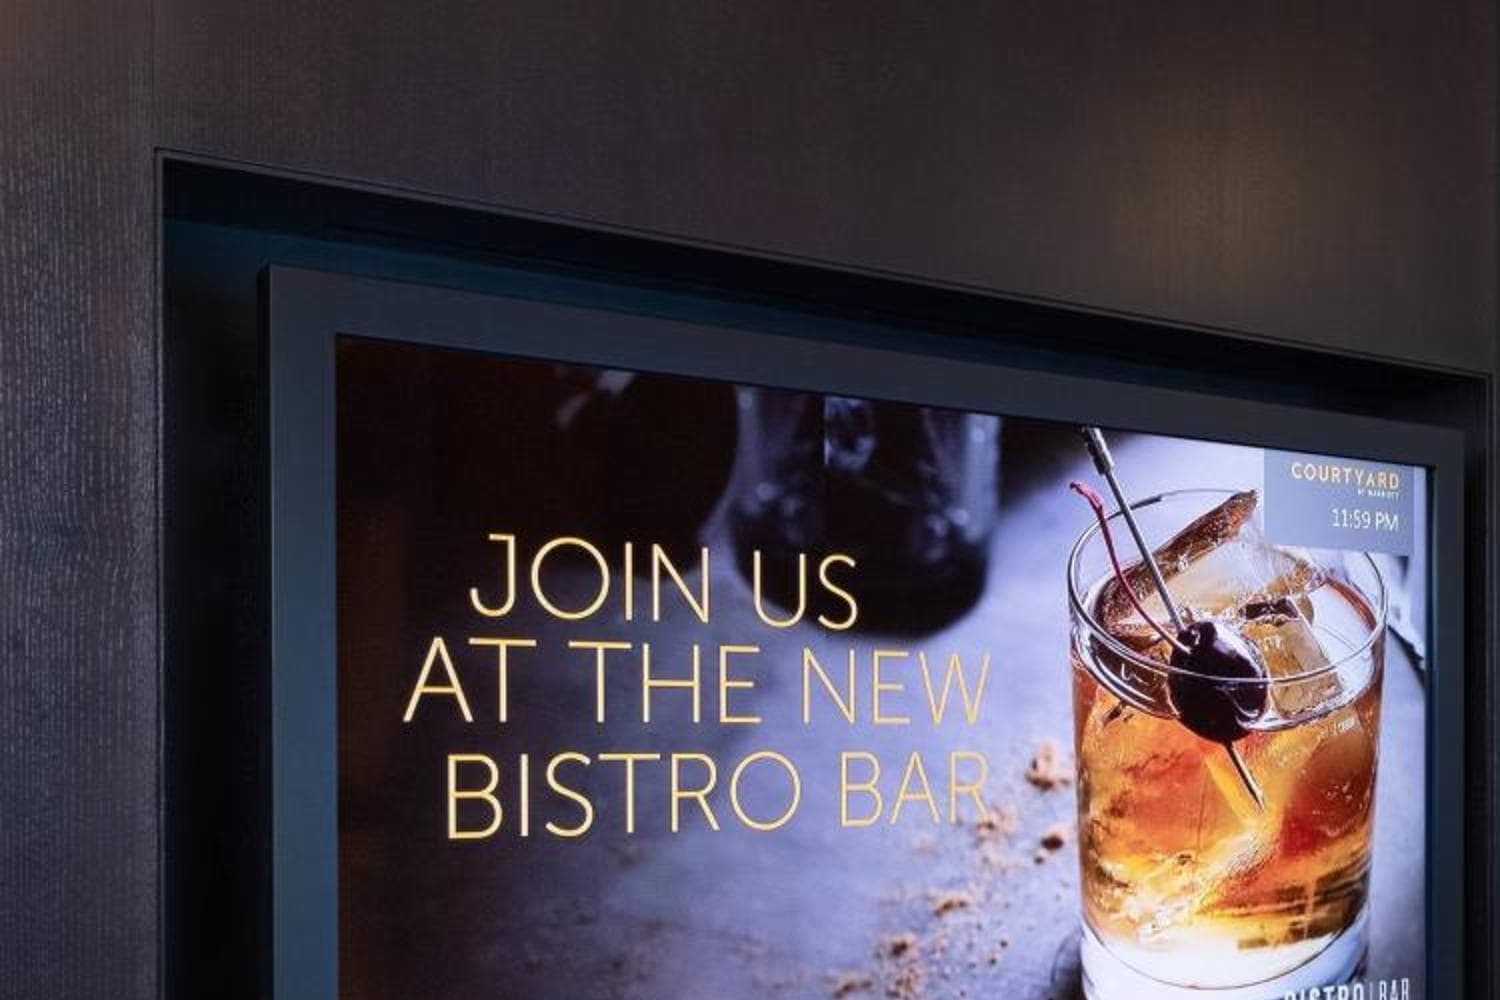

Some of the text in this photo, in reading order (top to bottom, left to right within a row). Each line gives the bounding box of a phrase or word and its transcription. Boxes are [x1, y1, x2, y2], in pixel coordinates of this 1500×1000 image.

[1291, 462, 1399, 489] COURTYARD
[1331, 508, 1399, 531] 11:59 PM
[470, 533, 858, 630] JOIN US
[403, 636, 992, 726] AT THE NEW
[447, 751, 992, 840] BISTRO BAR
